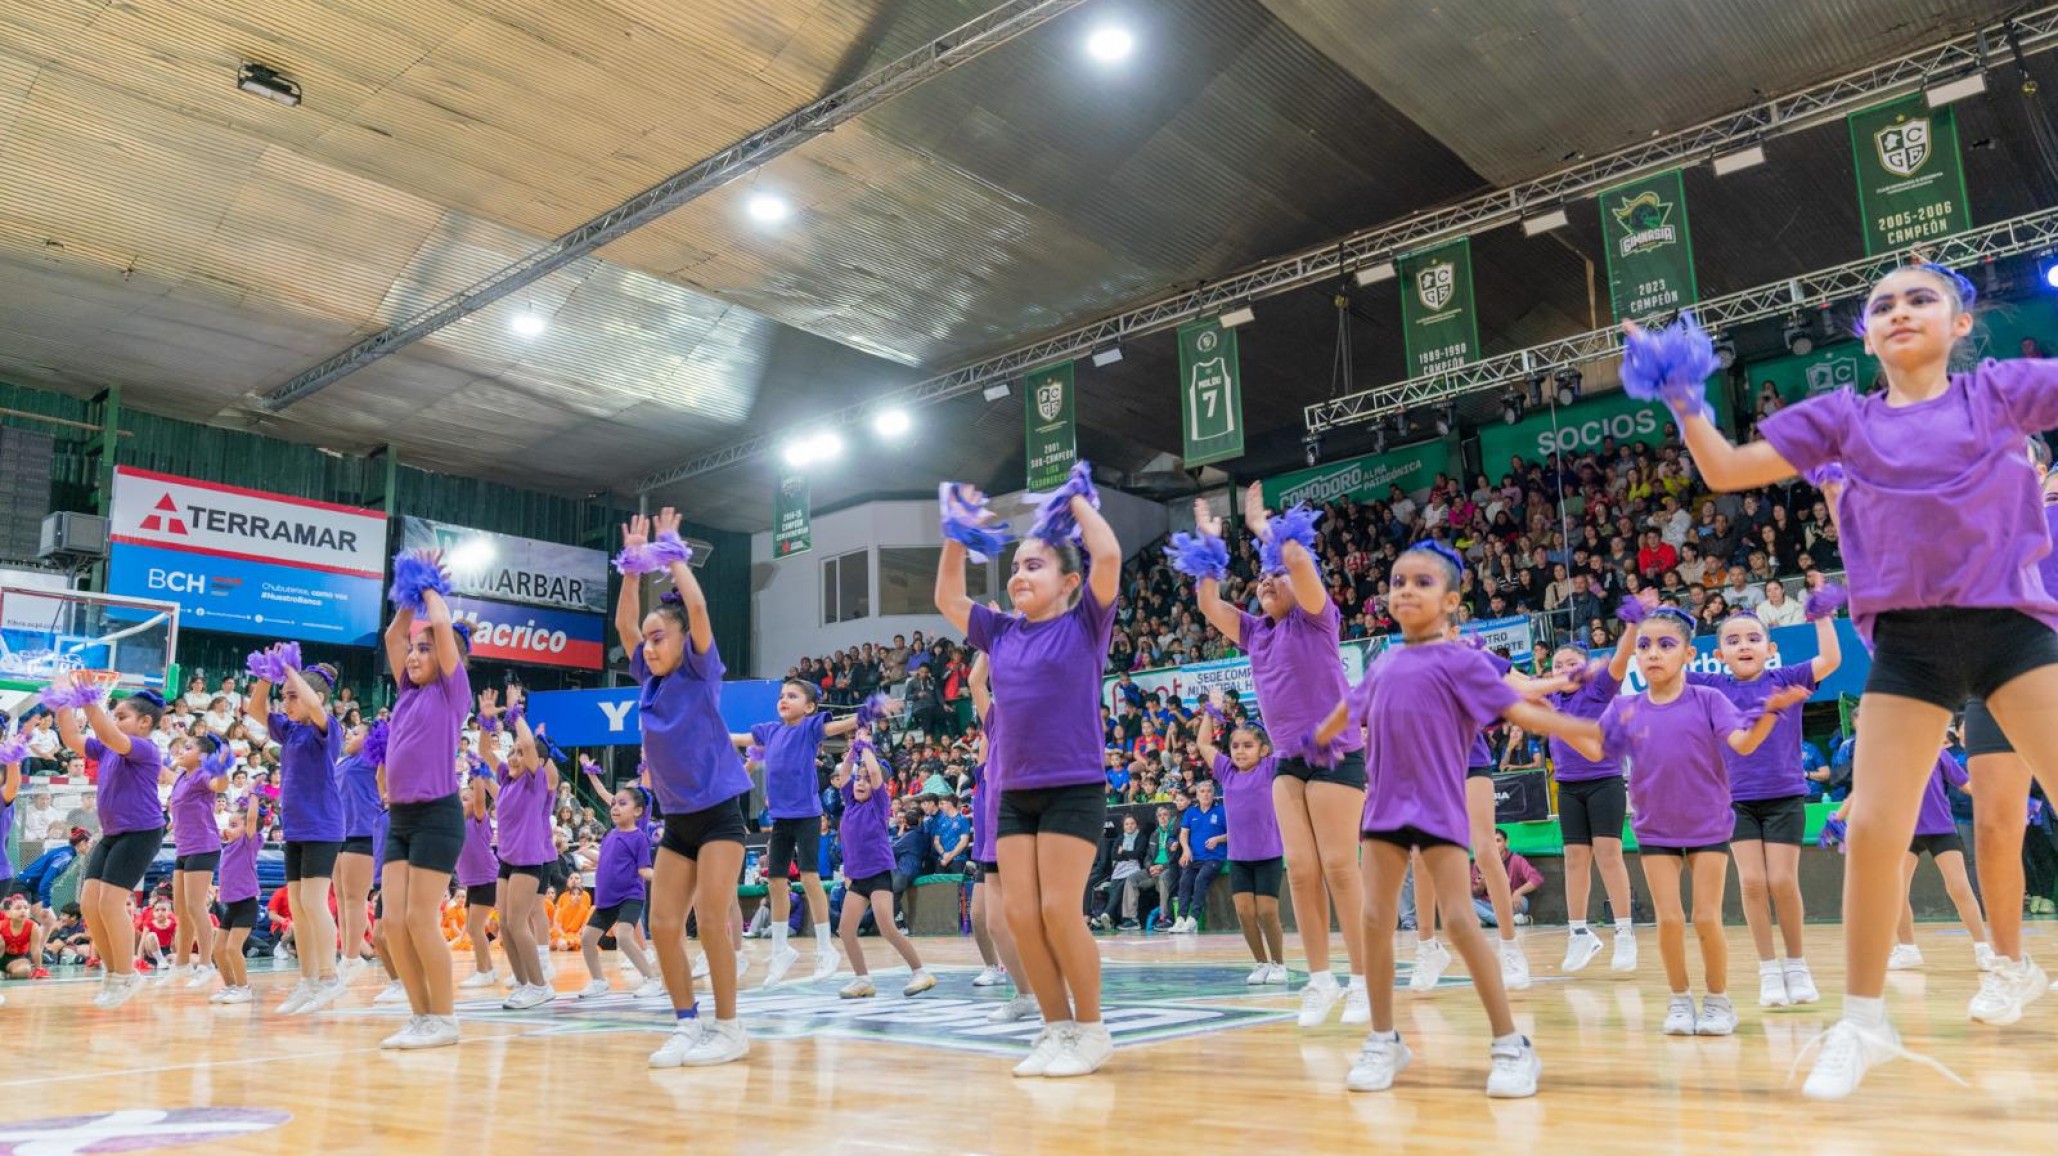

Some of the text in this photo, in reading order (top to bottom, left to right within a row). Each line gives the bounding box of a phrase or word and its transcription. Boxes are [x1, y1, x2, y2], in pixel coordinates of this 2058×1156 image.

[1878, 201, 1953, 231] 2005-2006
[1621, 227, 1673, 253] GIMNASIA
[1887, 218, 1947, 245] CAMPEÓN
[1639, 279, 1665, 296] 2023
[1630, 290, 1678, 314] CAMPEÓN
[1419, 342, 1467, 364] 1989-1990
[1202, 389, 1218, 418] 7
[1537, 409, 1656, 456] SOCIOS
[1280, 463, 1387, 510] COMODORO ALMA
[1364, 459, 1422, 491] PATAGÓNICA
[187, 504, 358, 553] TERRAMAR
[148, 568, 205, 595] BCH
[1197, 671, 1223, 685] SEDE
